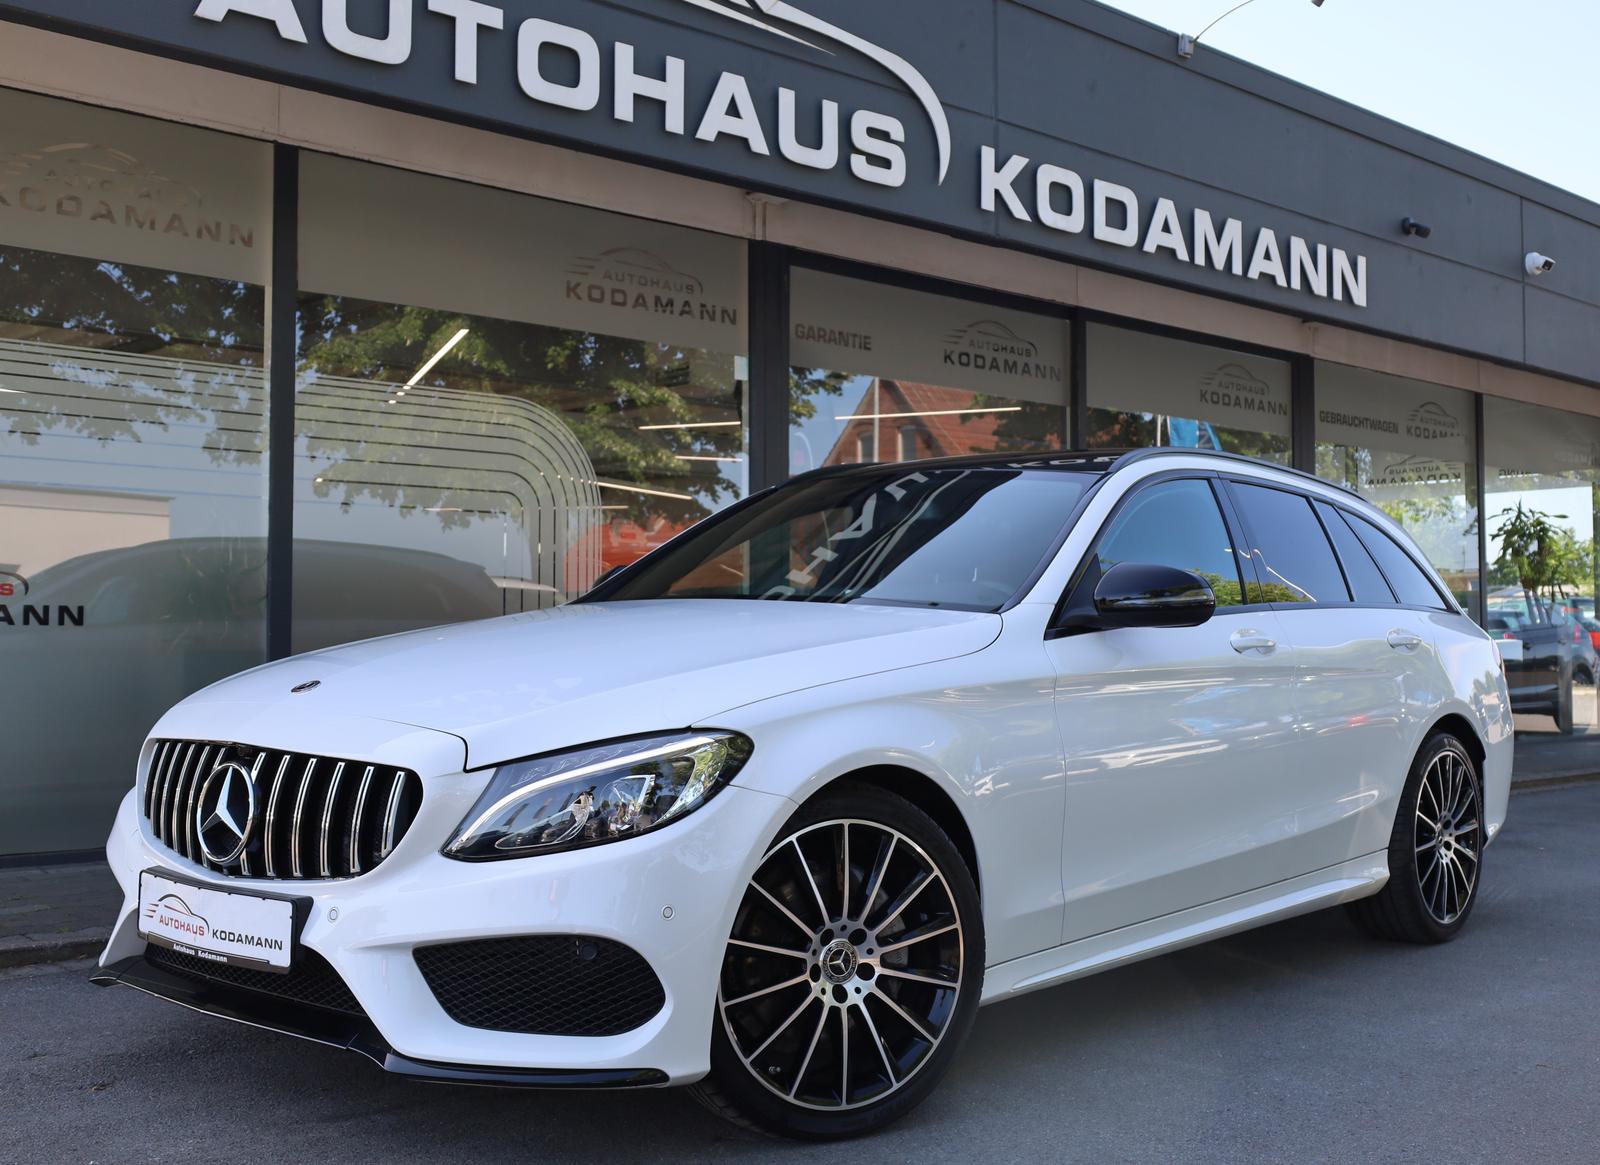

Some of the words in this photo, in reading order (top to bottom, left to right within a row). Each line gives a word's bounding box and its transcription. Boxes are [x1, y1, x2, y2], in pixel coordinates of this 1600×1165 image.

[980, 145, 1367, 307] KODAMANN
[603, 269, 695, 295] AUTOHAUS
[565, 280, 738, 326] KODAMANN
[794, 323, 872, 351] GARANTIE
[968, 338, 1032, 358] AUTOHAUS
[943, 349, 1061, 382] KODAMANN
[1217, 380, 1266, 396] AUTOHAUS
[1199, 388, 1288, 416] KODAMANN
[1319, 410, 1399, 434] GEBRAUCHTWAGEN
[1406, 424, 1463, 440] KODAM
[159, 915, 205, 936] AUTOHAUS
[212, 928, 283, 951] KODAMANN
[198, 949, 228, 963] Kodamann
